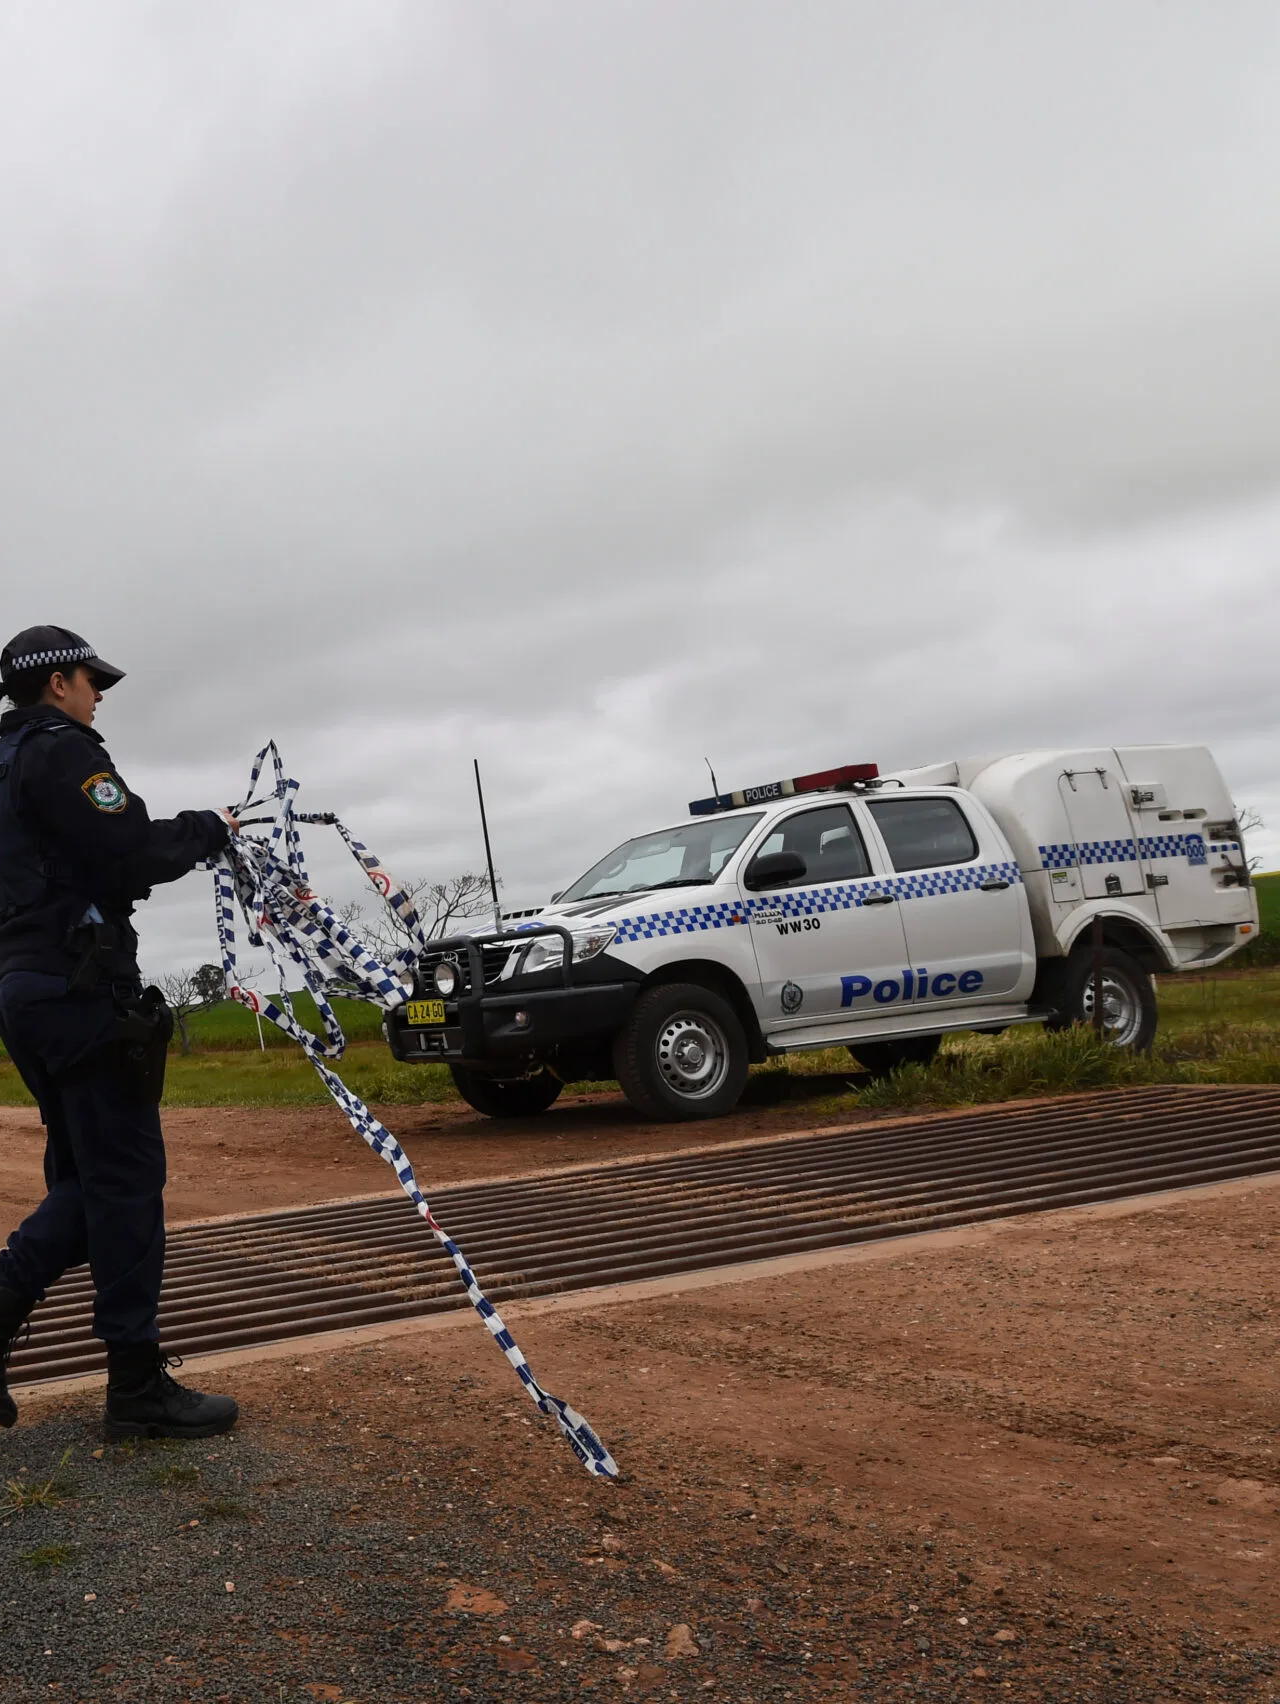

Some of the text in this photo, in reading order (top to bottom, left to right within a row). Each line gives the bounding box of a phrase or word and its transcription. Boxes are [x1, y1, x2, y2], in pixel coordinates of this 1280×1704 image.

[745, 784, 779, 802] POLICE
[1187, 844, 1205, 857] 000
[776, 918, 821, 935] WW30
[840, 968, 984, 1007] Police
